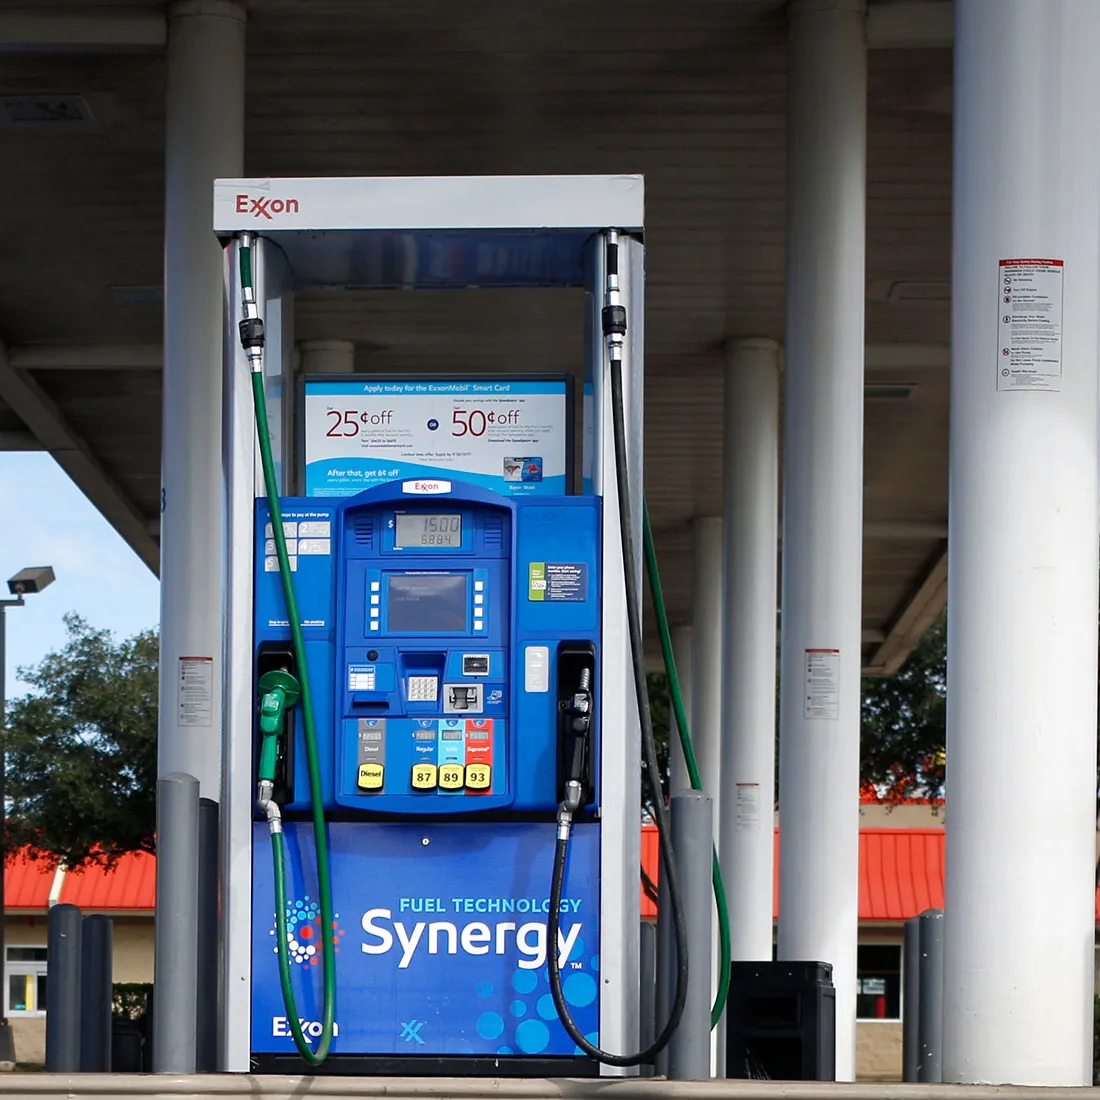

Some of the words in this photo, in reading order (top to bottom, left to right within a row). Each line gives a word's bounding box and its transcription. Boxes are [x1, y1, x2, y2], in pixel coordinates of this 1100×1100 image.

[236, 195, 298, 219] Exxon
[415, 482, 438, 491] Exxon
[388, 520, 394, 529] $
[417, 773, 431, 782] 87
[444, 773, 458, 782] 89
[470, 773, 485, 782] 93
[400, 898, 446, 912] FUEL
[452, 899, 582, 912] TECHNOLOGY
[361, 908, 582, 968] Synergy
